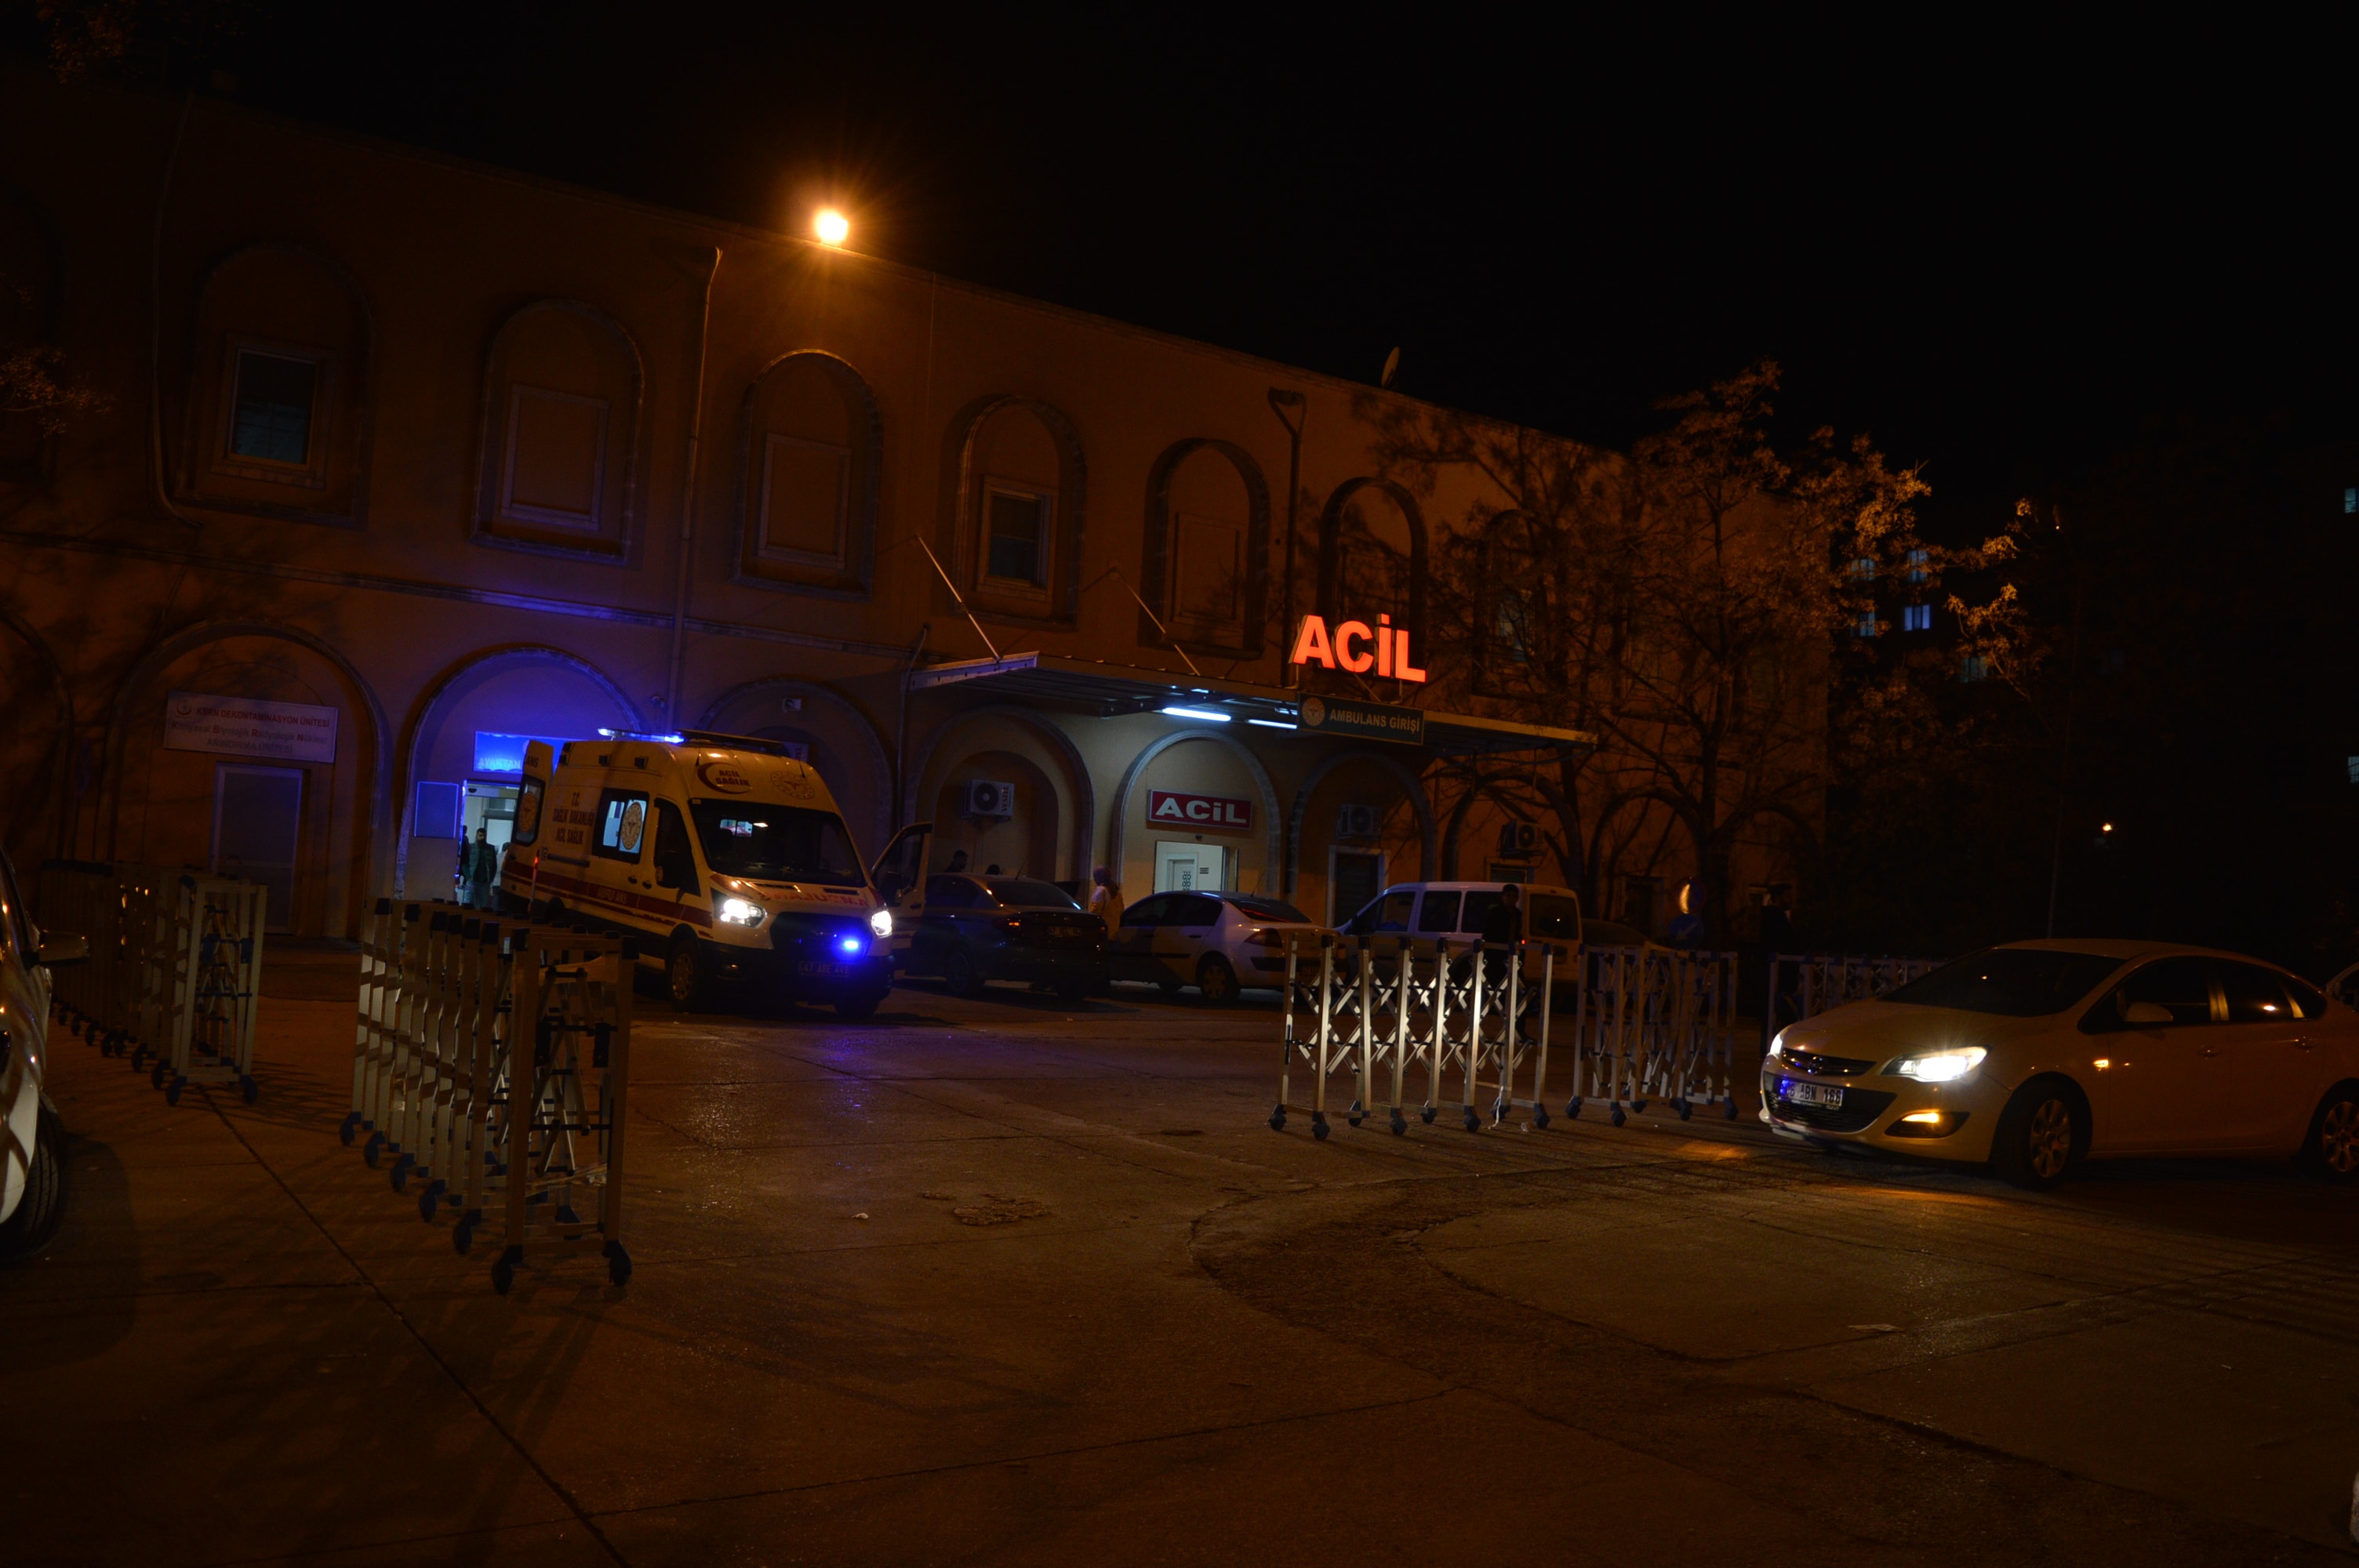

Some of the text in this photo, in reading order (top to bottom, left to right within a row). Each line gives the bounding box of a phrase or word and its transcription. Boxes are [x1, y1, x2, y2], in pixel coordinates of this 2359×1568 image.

[1290, 613, 1427, 683] ACİL
[197, 707, 330, 728] KBRN DEKONTAMİNASYON ÜNİTESİ
[1330, 709, 1421, 734] AMBULANS GİRİŞİ
[715, 777, 751, 786] SAĞLIK
